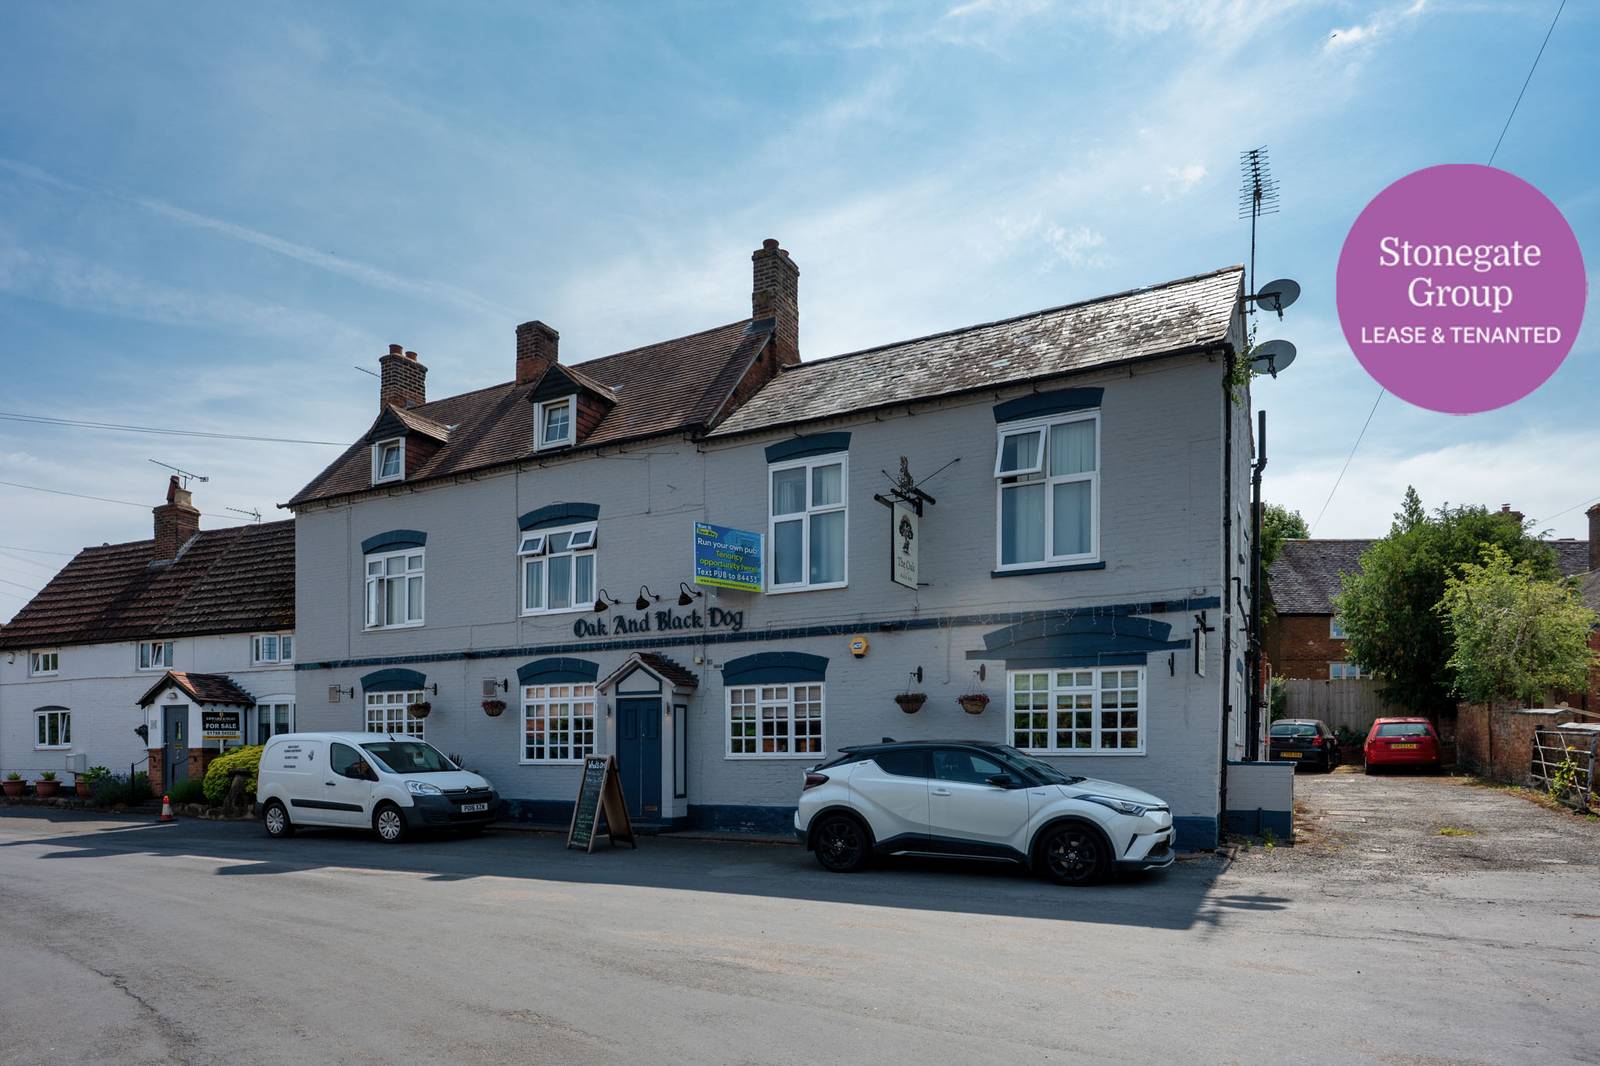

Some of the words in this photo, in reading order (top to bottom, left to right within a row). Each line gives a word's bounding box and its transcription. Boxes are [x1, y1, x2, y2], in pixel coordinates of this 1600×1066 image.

[697, 537, 712, 547] Run
[713, 541, 728, 550] your
[728, 544, 743, 552] own
[716, 551, 743, 562] Tenancy
[699, 559, 740, 571] opportunity
[697, 568, 713, 576] Text
[713, 570, 727, 578] PUB
[573, 617, 608, 638] Oak
[613, 612, 650, 635] And
[655, 608, 704, 632] Black
[707, 606, 743, 632] Dog
